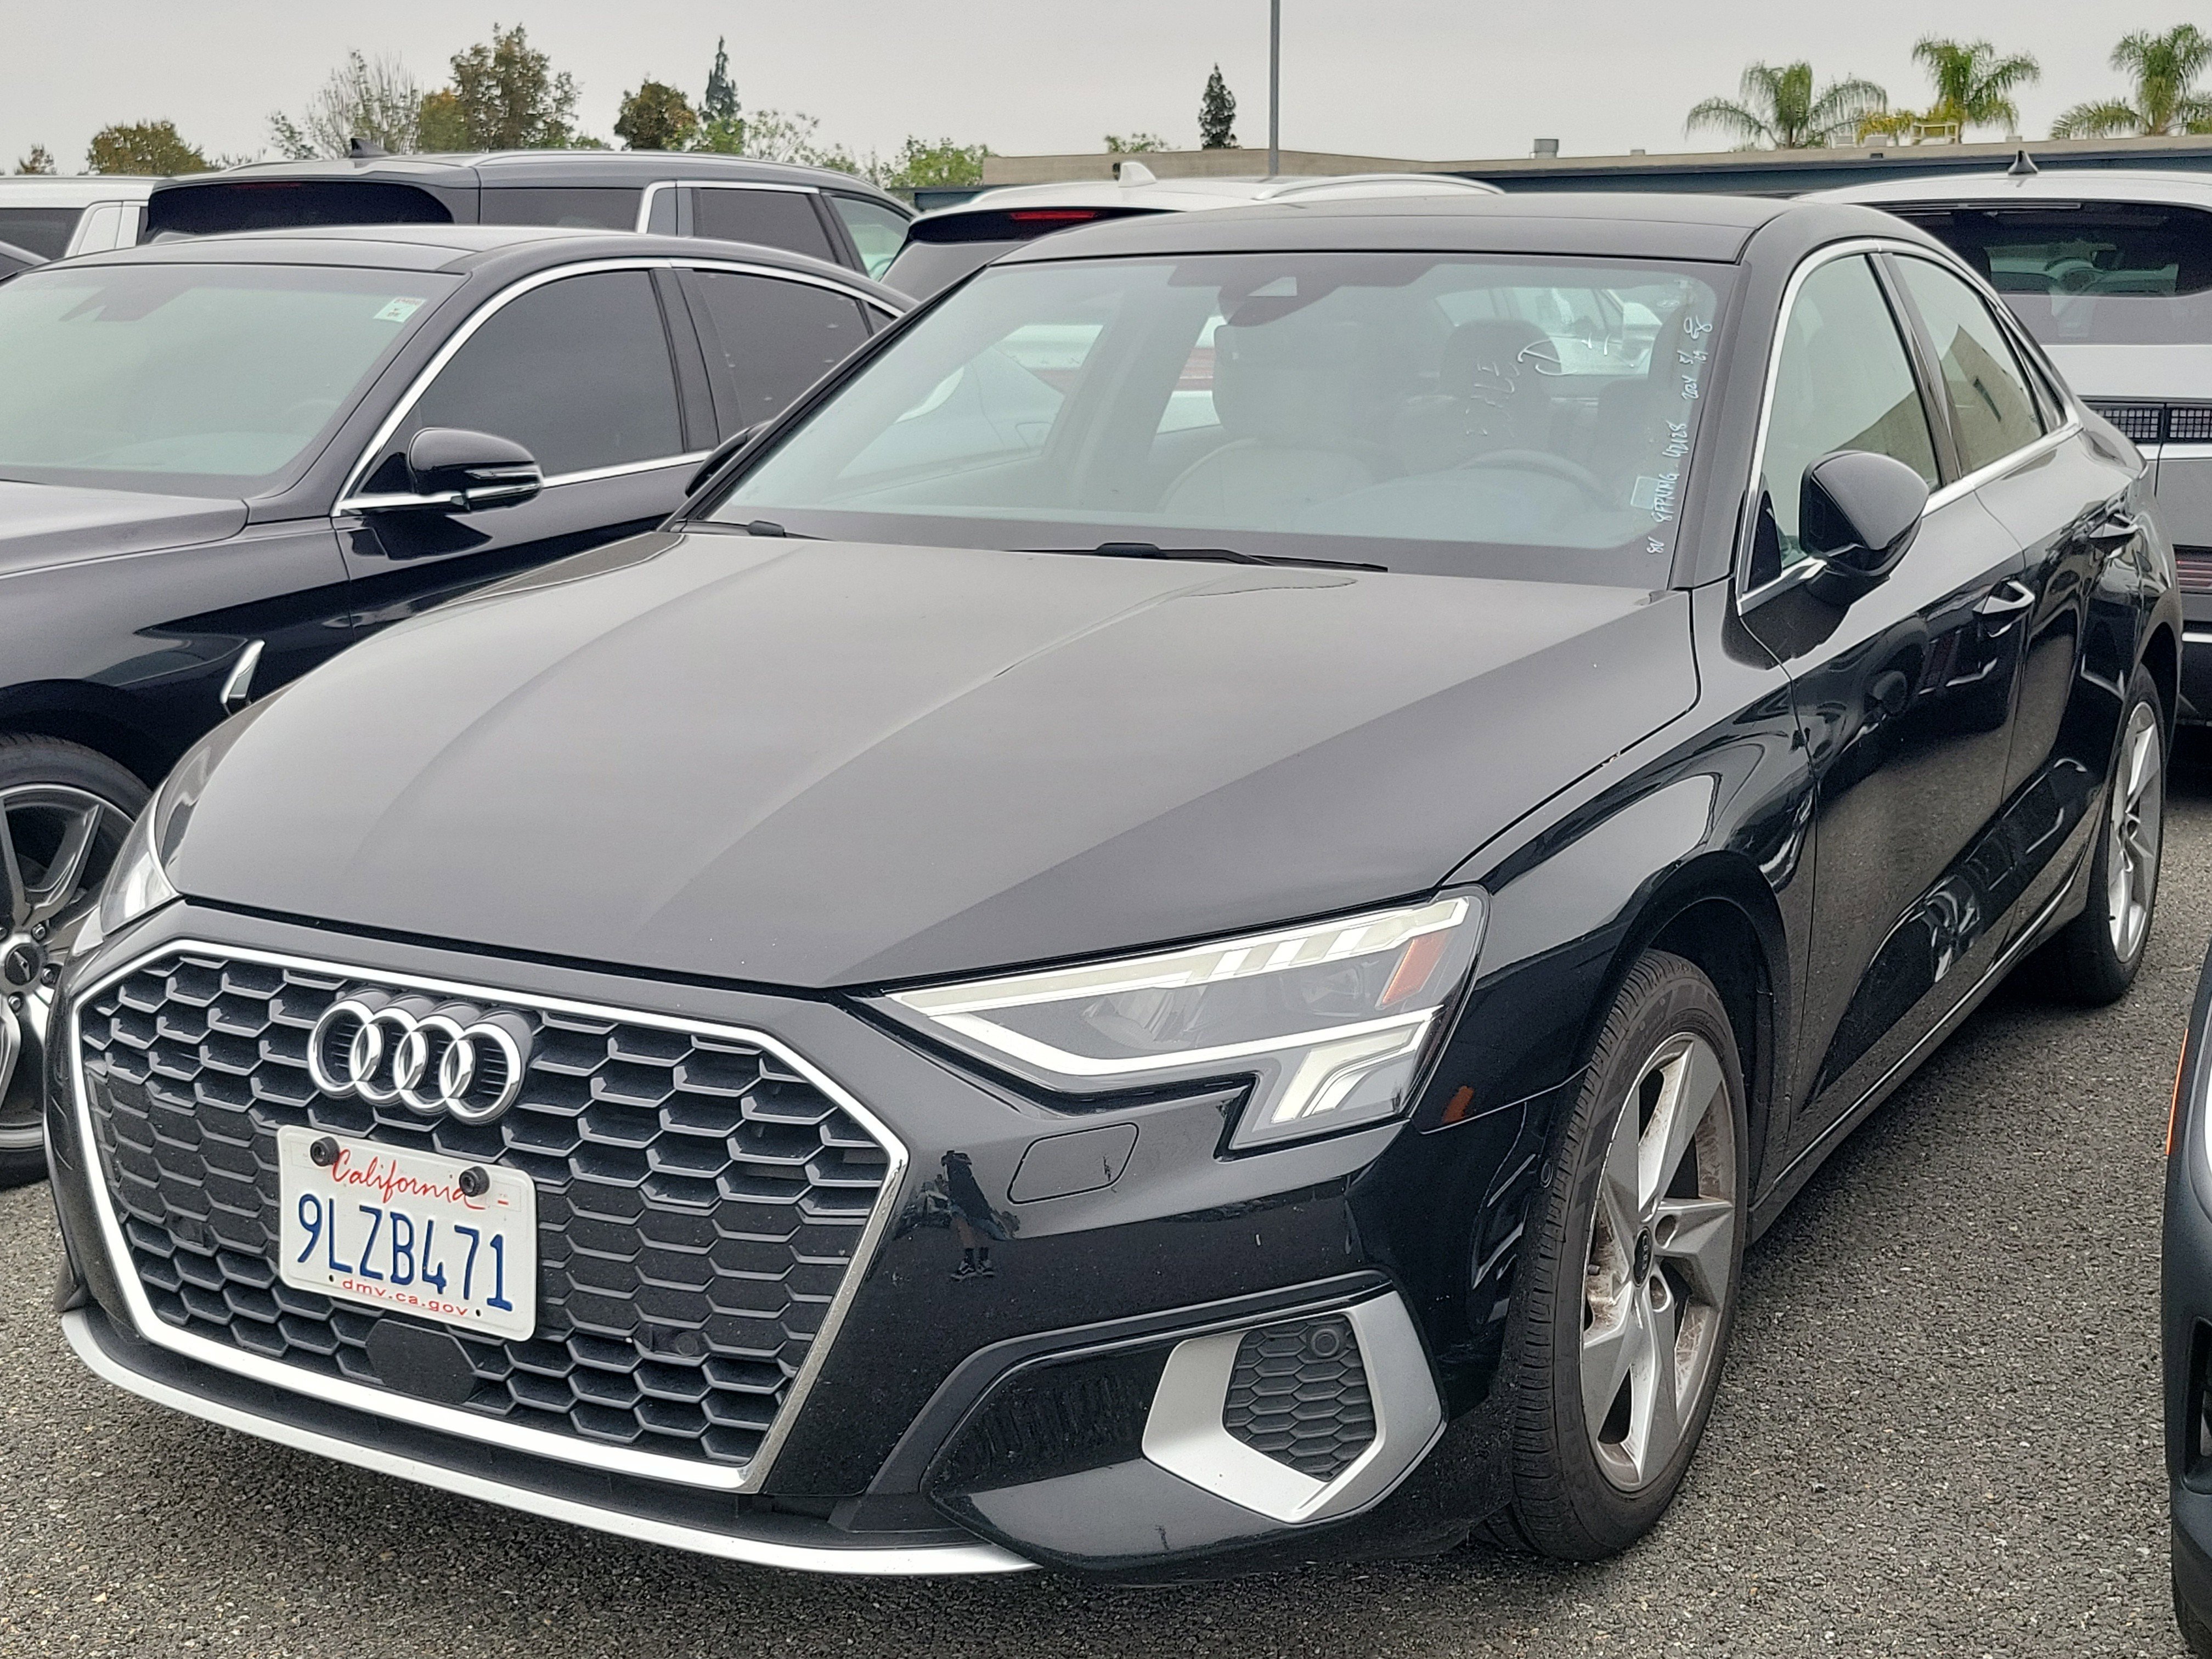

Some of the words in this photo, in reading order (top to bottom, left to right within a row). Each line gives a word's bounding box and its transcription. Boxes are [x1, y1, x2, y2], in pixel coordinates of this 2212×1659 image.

[332, 1148, 486, 1210] California
[297, 1193, 514, 1312] 9LZB471
[342, 1279, 469, 1316] dmv.ca.gov
